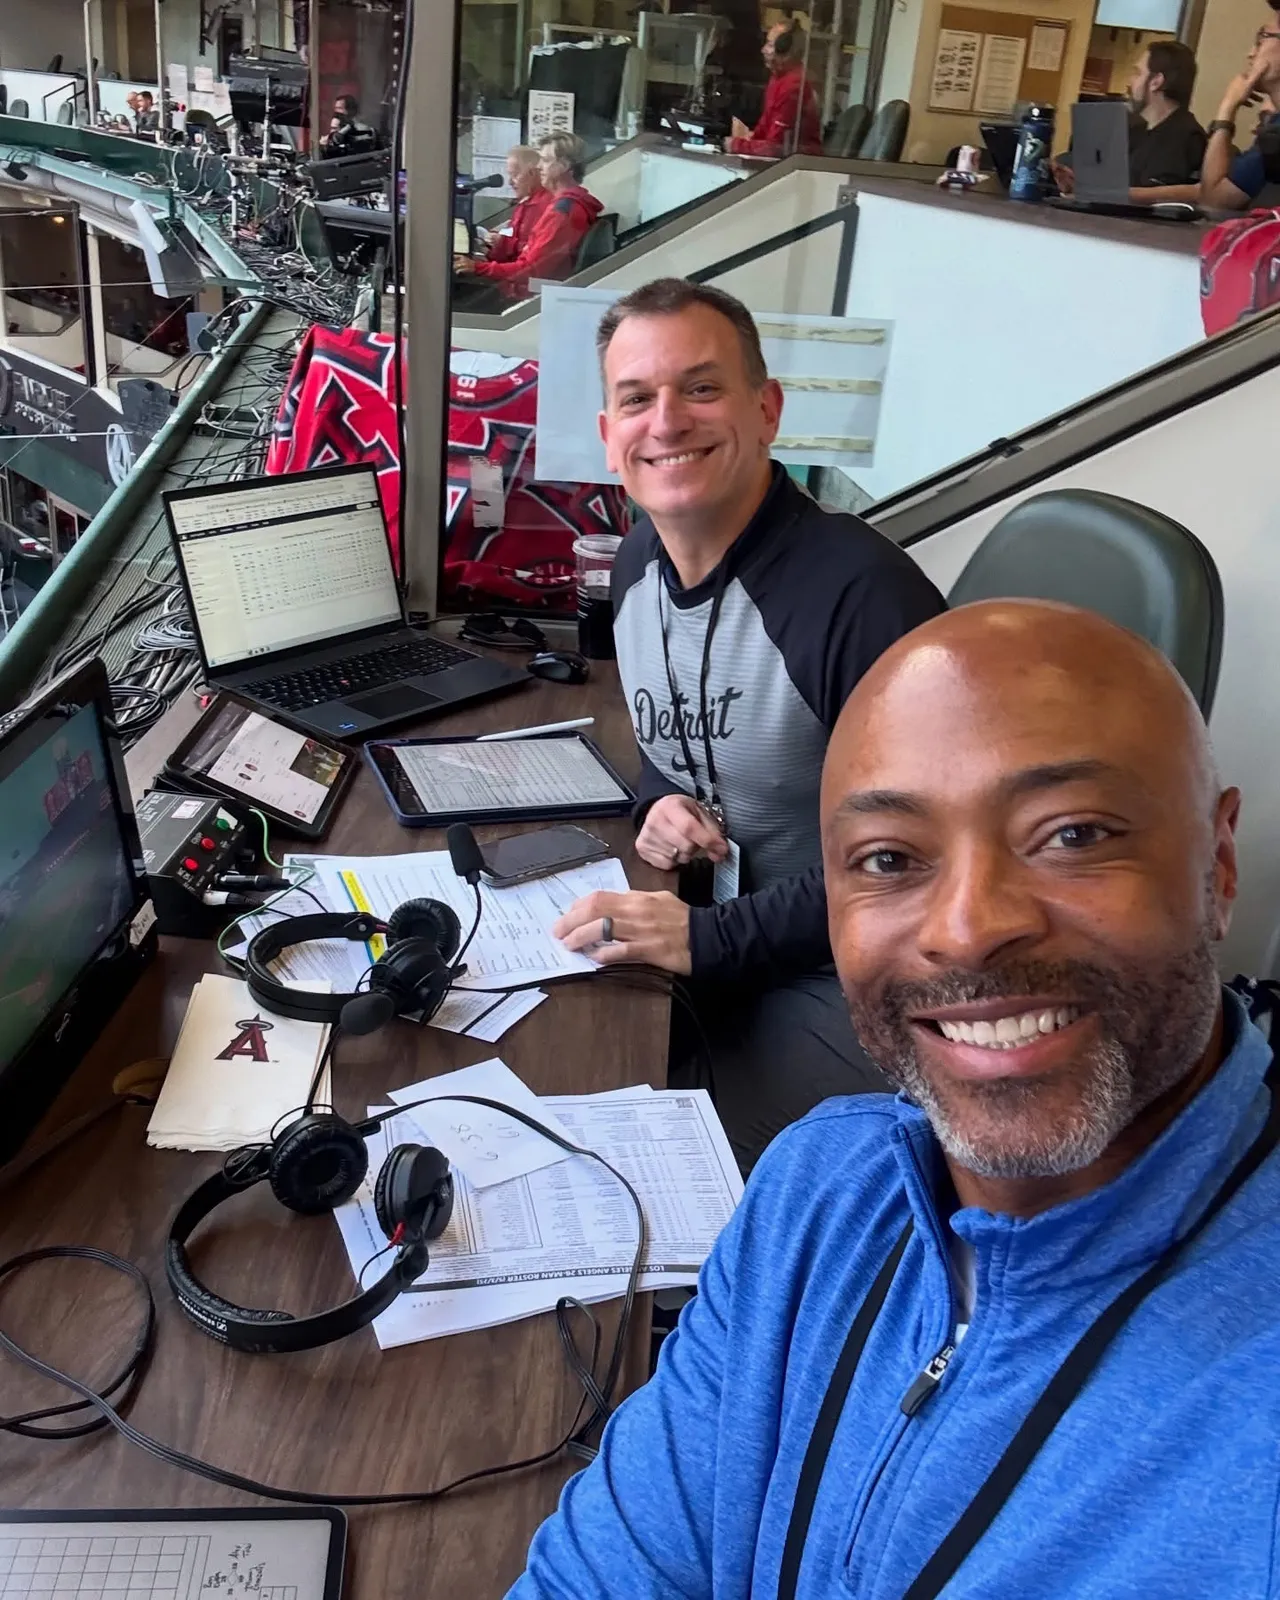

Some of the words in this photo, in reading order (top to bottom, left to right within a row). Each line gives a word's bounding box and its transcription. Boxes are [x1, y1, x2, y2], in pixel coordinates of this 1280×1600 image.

[634, 687, 744, 745] Detroit
[214, 1012, 270, 1063] A
[507, 1273, 540, 1281] ROSTER
[541, 1270, 576, 1279] 26-MAN
